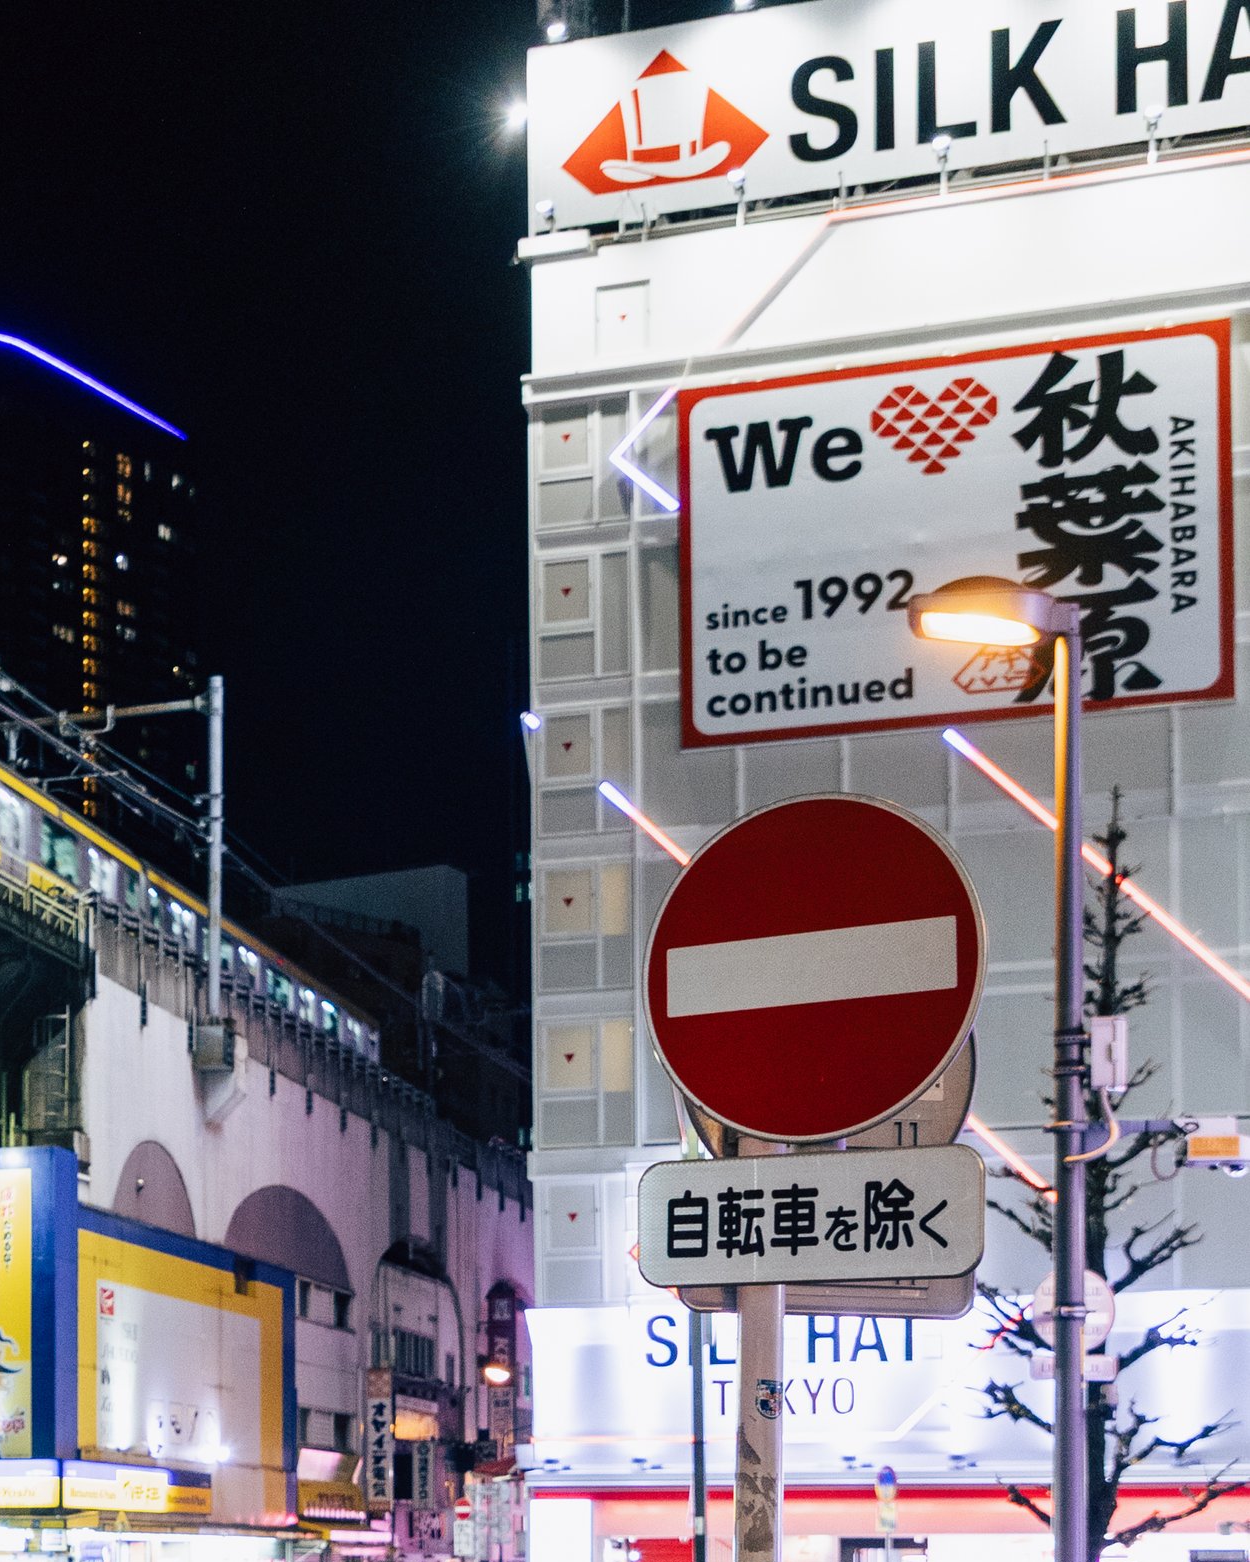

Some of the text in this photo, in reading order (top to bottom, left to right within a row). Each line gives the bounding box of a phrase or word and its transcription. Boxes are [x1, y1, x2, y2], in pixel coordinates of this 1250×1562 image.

[789, 19, 1068, 163] SILK
[705, 416, 862, 493] We
[1169, 416, 1198, 614] AKIHABARA
[706, 570, 915, 631] since 1992
[708, 643, 808, 674] to be
[708, 669, 914, 717] continued
[667, 1178, 949, 1260] 自転車を除く
[713, 1377, 855, 1416] TKYO
